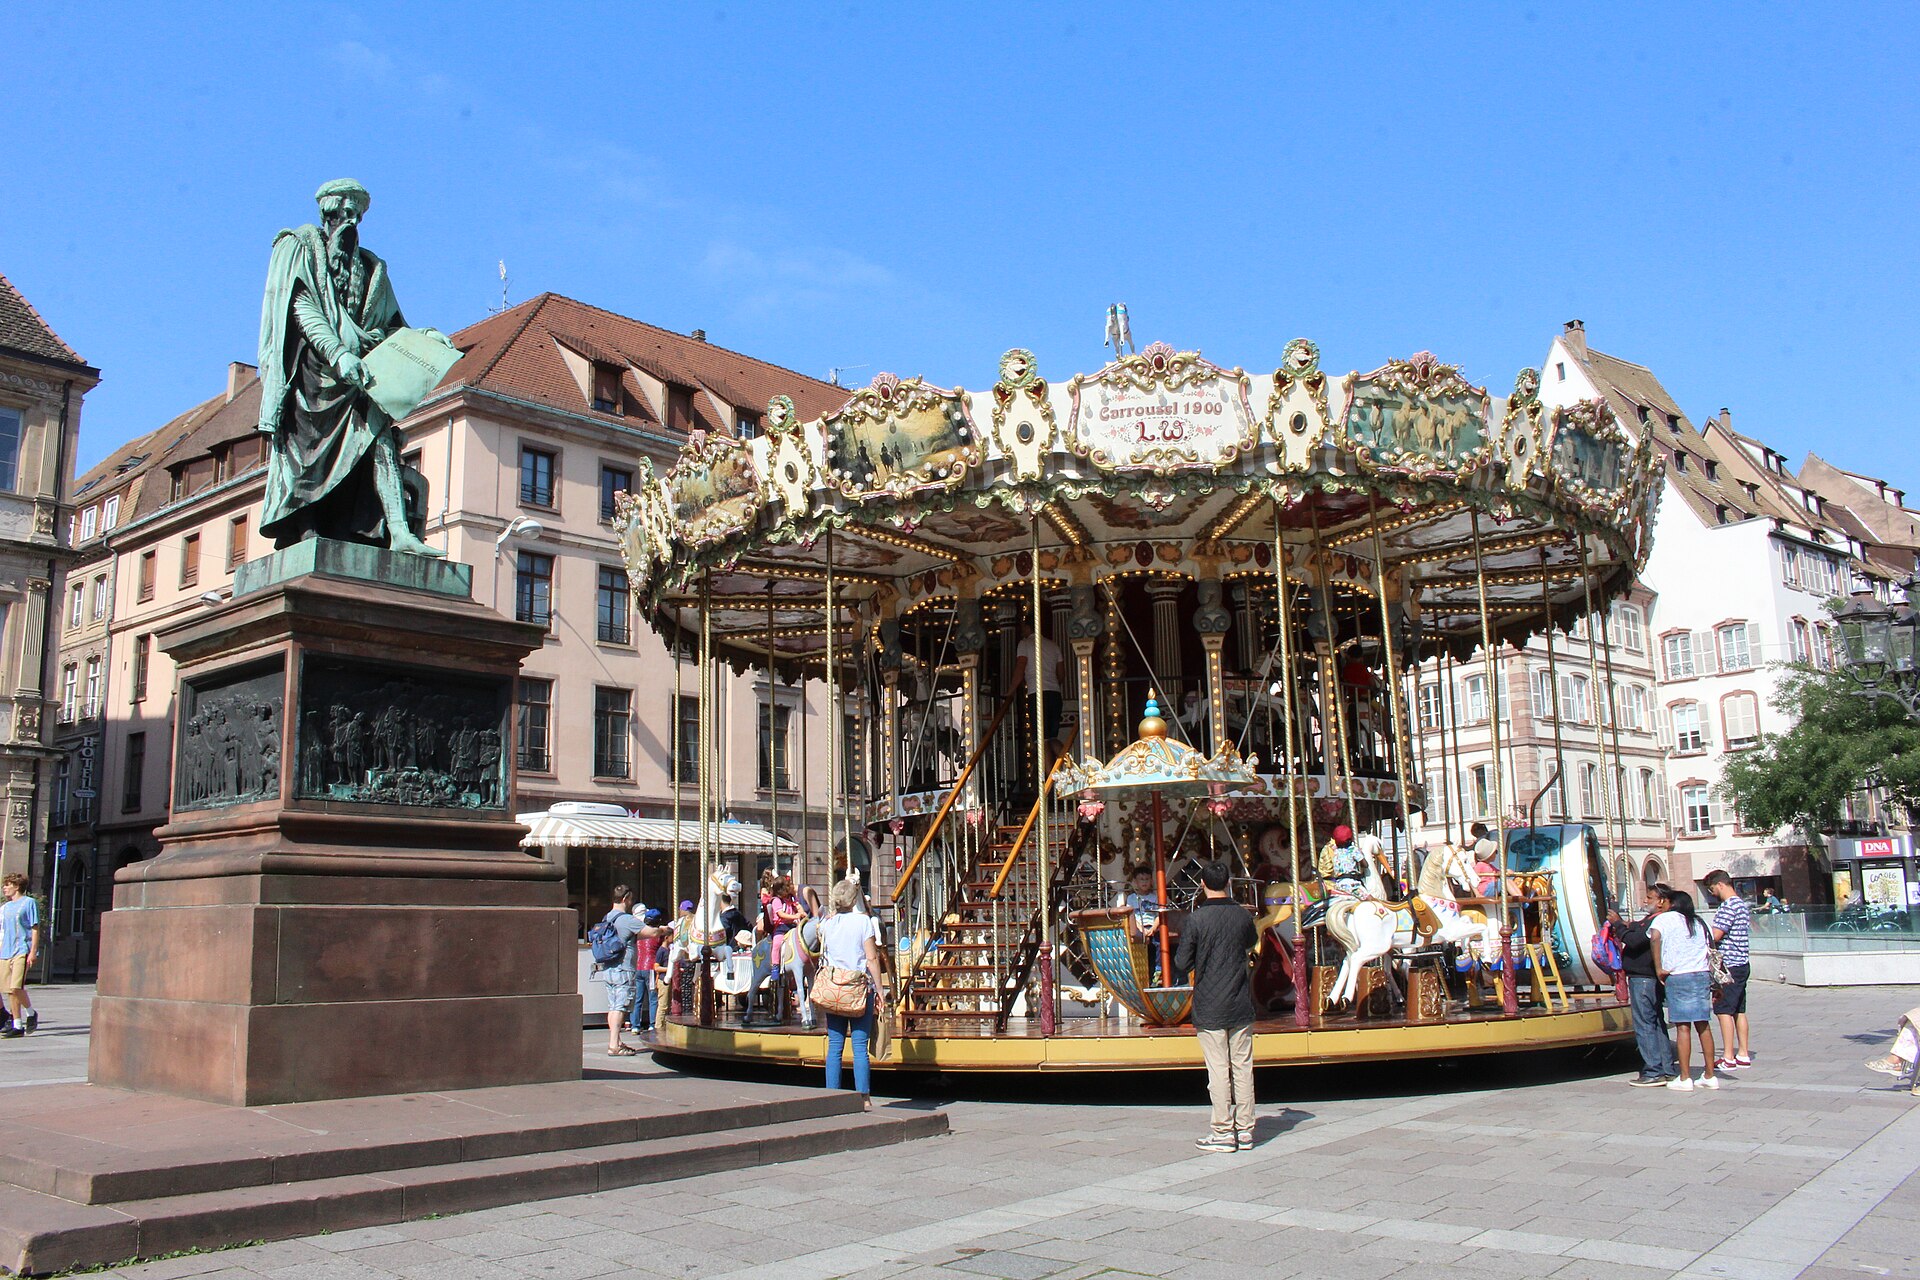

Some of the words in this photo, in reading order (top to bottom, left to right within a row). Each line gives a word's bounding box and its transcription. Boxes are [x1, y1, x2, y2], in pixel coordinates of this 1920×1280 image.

[1100, 402, 1178, 421] Carrousel
[1183, 402, 1223, 415] 1900
[1135, 420, 1188, 442] L.W.
[81, 736, 94, 789] HOTEL
[1864, 842, 1889, 851] DNA
